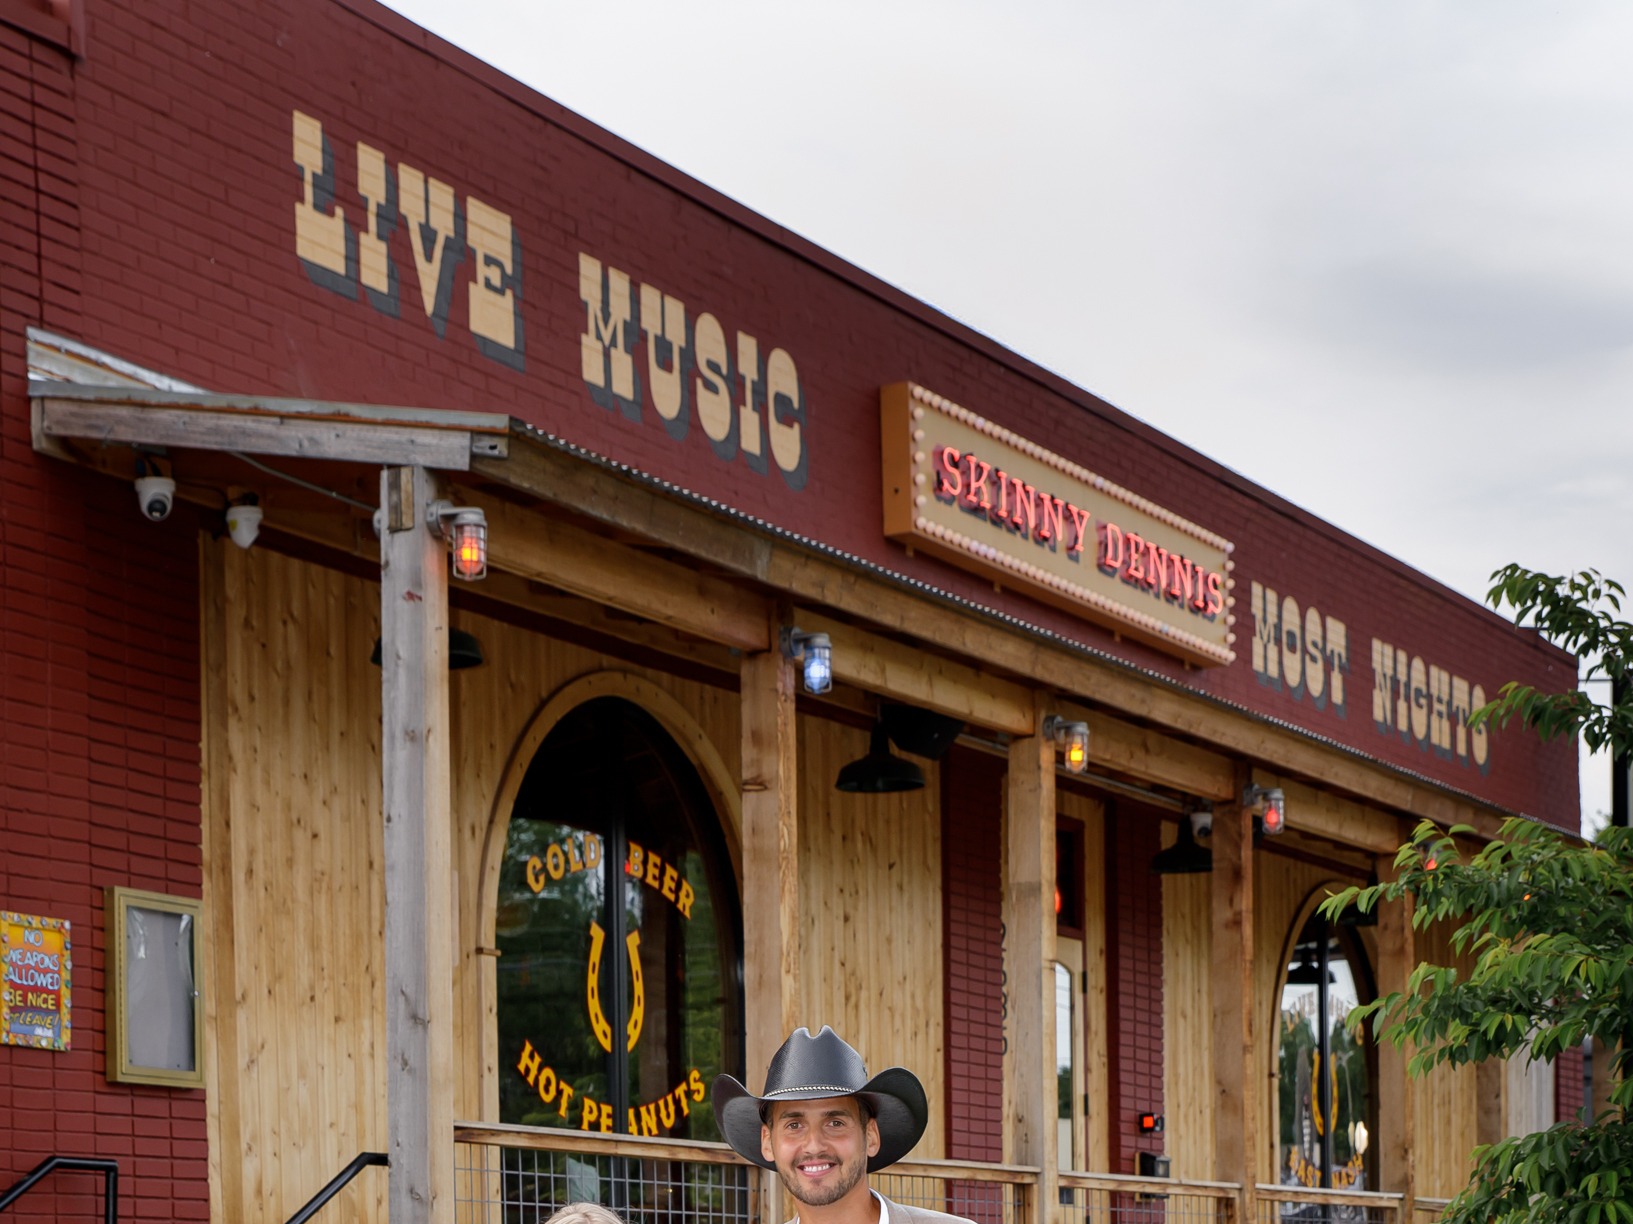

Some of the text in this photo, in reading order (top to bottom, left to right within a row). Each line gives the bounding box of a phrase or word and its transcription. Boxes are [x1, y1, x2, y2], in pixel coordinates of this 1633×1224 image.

[293, 110, 801, 472] LIVE MUSIC
[942, 446, 1223, 614] SKINNY DENNIS
[1251, 580, 1488, 766] MOST NIGHTS
[526, 833, 696, 919] COLD BEER
[7, 948, 60, 971] WEAPONS
[24, 928, 43, 947] NO
[5, 966, 61, 990] ALLOWED
[9, 988, 24, 1007] BE
[517, 1039, 574, 1119] HOT
